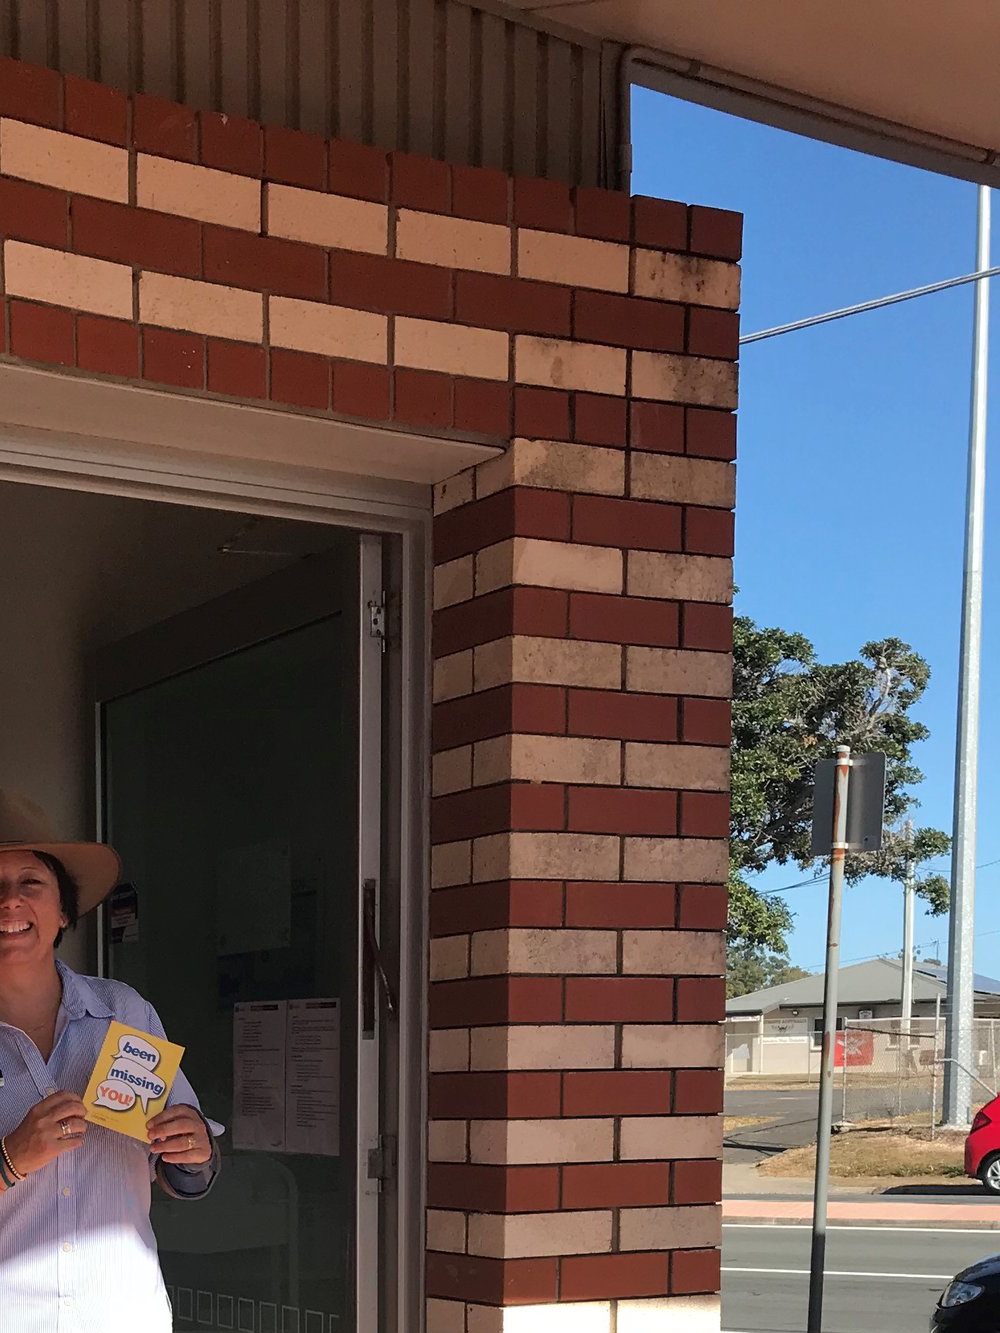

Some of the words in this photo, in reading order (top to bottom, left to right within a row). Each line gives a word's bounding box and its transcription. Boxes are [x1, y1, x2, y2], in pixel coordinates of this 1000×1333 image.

[123, 1041, 157, 1062] been
[110, 1067, 164, 1096] missing
[100, 1086, 134, 1106] YOU!
